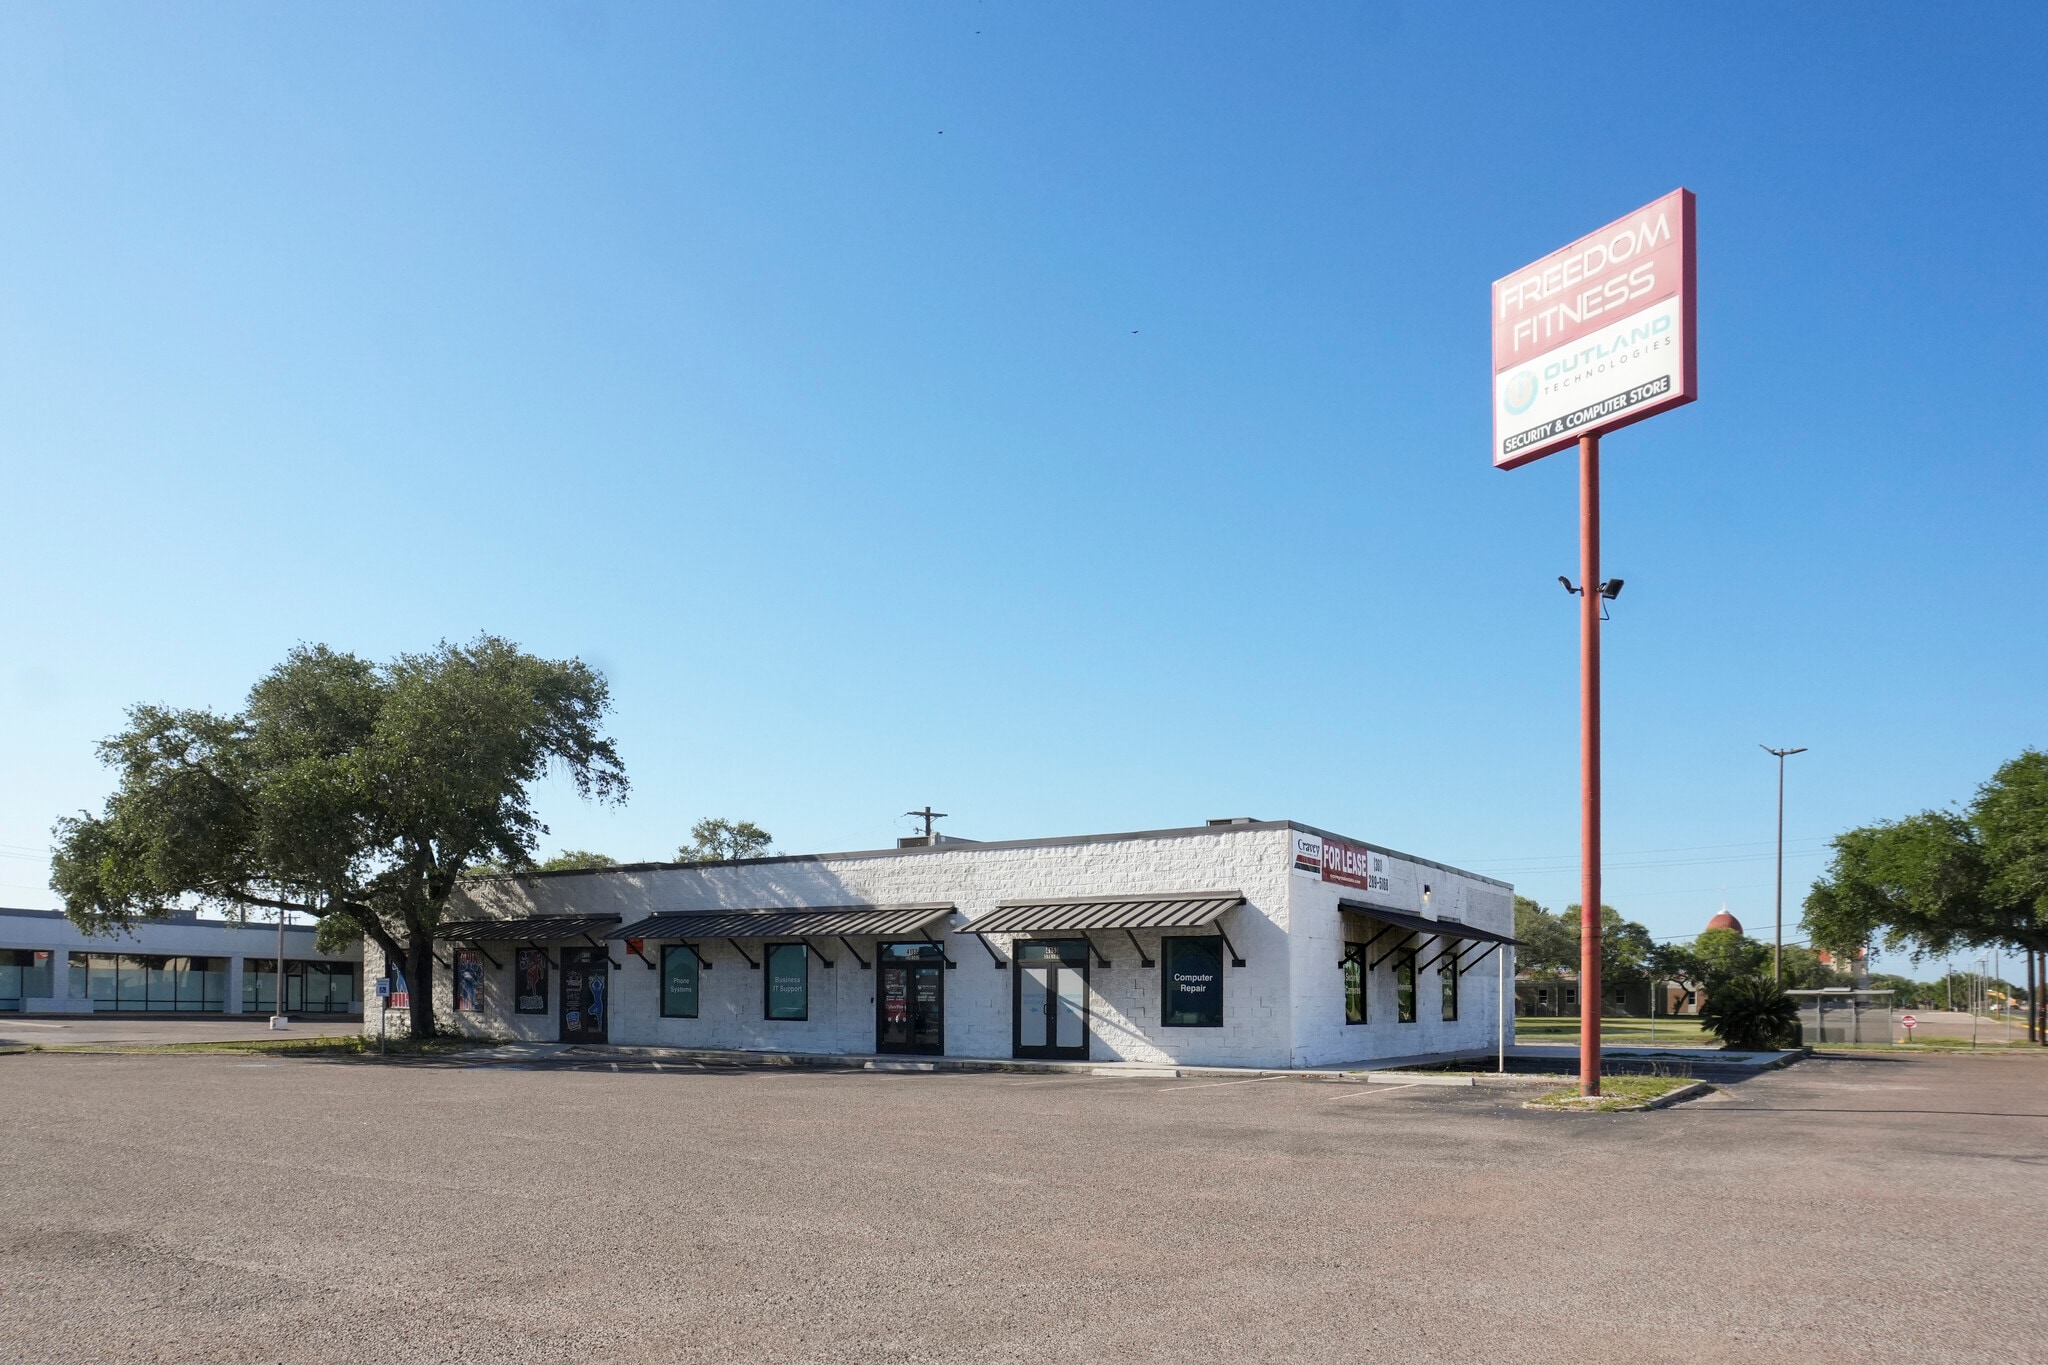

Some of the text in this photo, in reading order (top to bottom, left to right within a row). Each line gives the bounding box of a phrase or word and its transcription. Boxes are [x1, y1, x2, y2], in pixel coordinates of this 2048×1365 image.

[1500, 213, 1670, 318] FREEDOM
[1514, 261, 1655, 351] FITNESS
[1544, 313, 1671, 380] OUTLAND
[1544, 336, 1672, 395] TECHNOLOGIES
[1505, 377, 1668, 453] SECURITY & COMPUTER STORE
[1323, 844, 1341, 871] FOR
[1342, 850, 1367, 878] LEASE
[670, 986, 692, 994] Systems
[673, 977, 690, 985] Phone
[780, 985, 802, 994] Support
[1174, 973, 1213, 983] Computer
[1180, 984, 1206, 993] Repair
